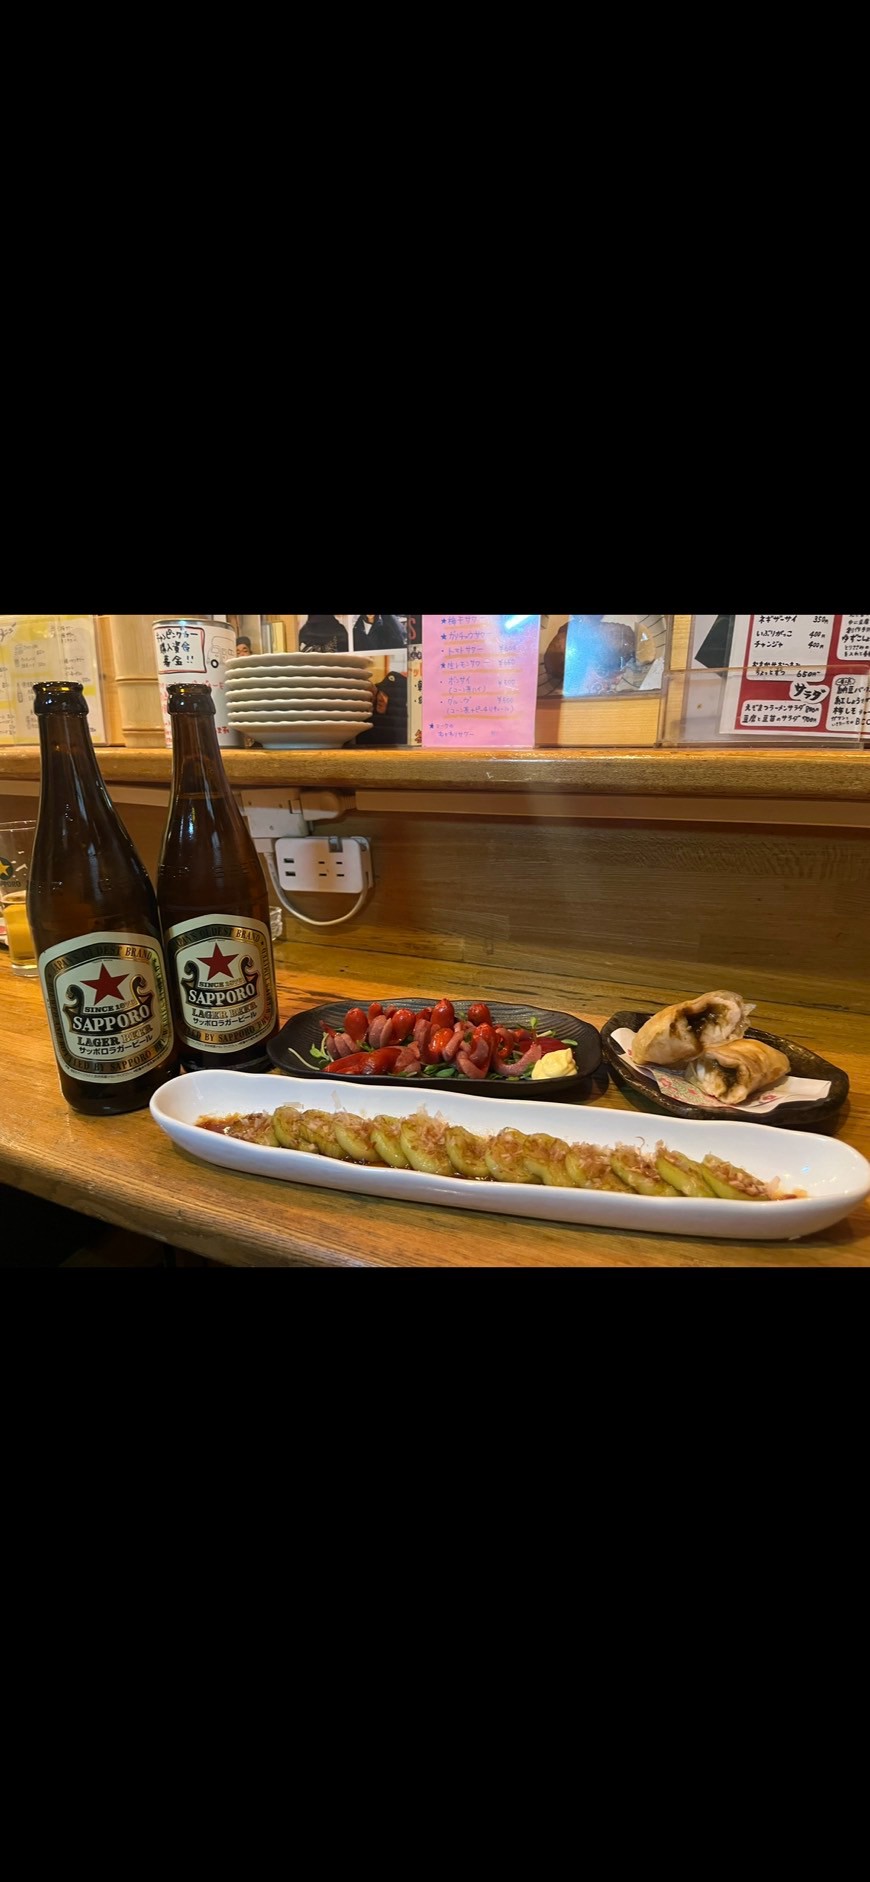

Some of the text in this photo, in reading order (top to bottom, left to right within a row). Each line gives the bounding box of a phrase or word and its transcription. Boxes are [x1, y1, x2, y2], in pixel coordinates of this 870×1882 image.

[754, 640, 784, 648] チャンジャ
[793, 682, 827, 701] サラダ
[235, 929, 261, 942] BRAND
[125, 946, 153, 960] BRAND
[188, 982, 256, 1006] SAPPORO
[84, 1005, 115, 1013] SINCE
[191, 1007, 229, 1020] LAGER
[72, 1004, 150, 1032] SAPPORO
[192, 1012, 258, 1027] サッポロラガービール
[77, 1036, 120, 1048] LAGER
[79, 1034, 153, 1055] サッポロラガービール
[110, 1048, 152, 1072] SAPPORO
